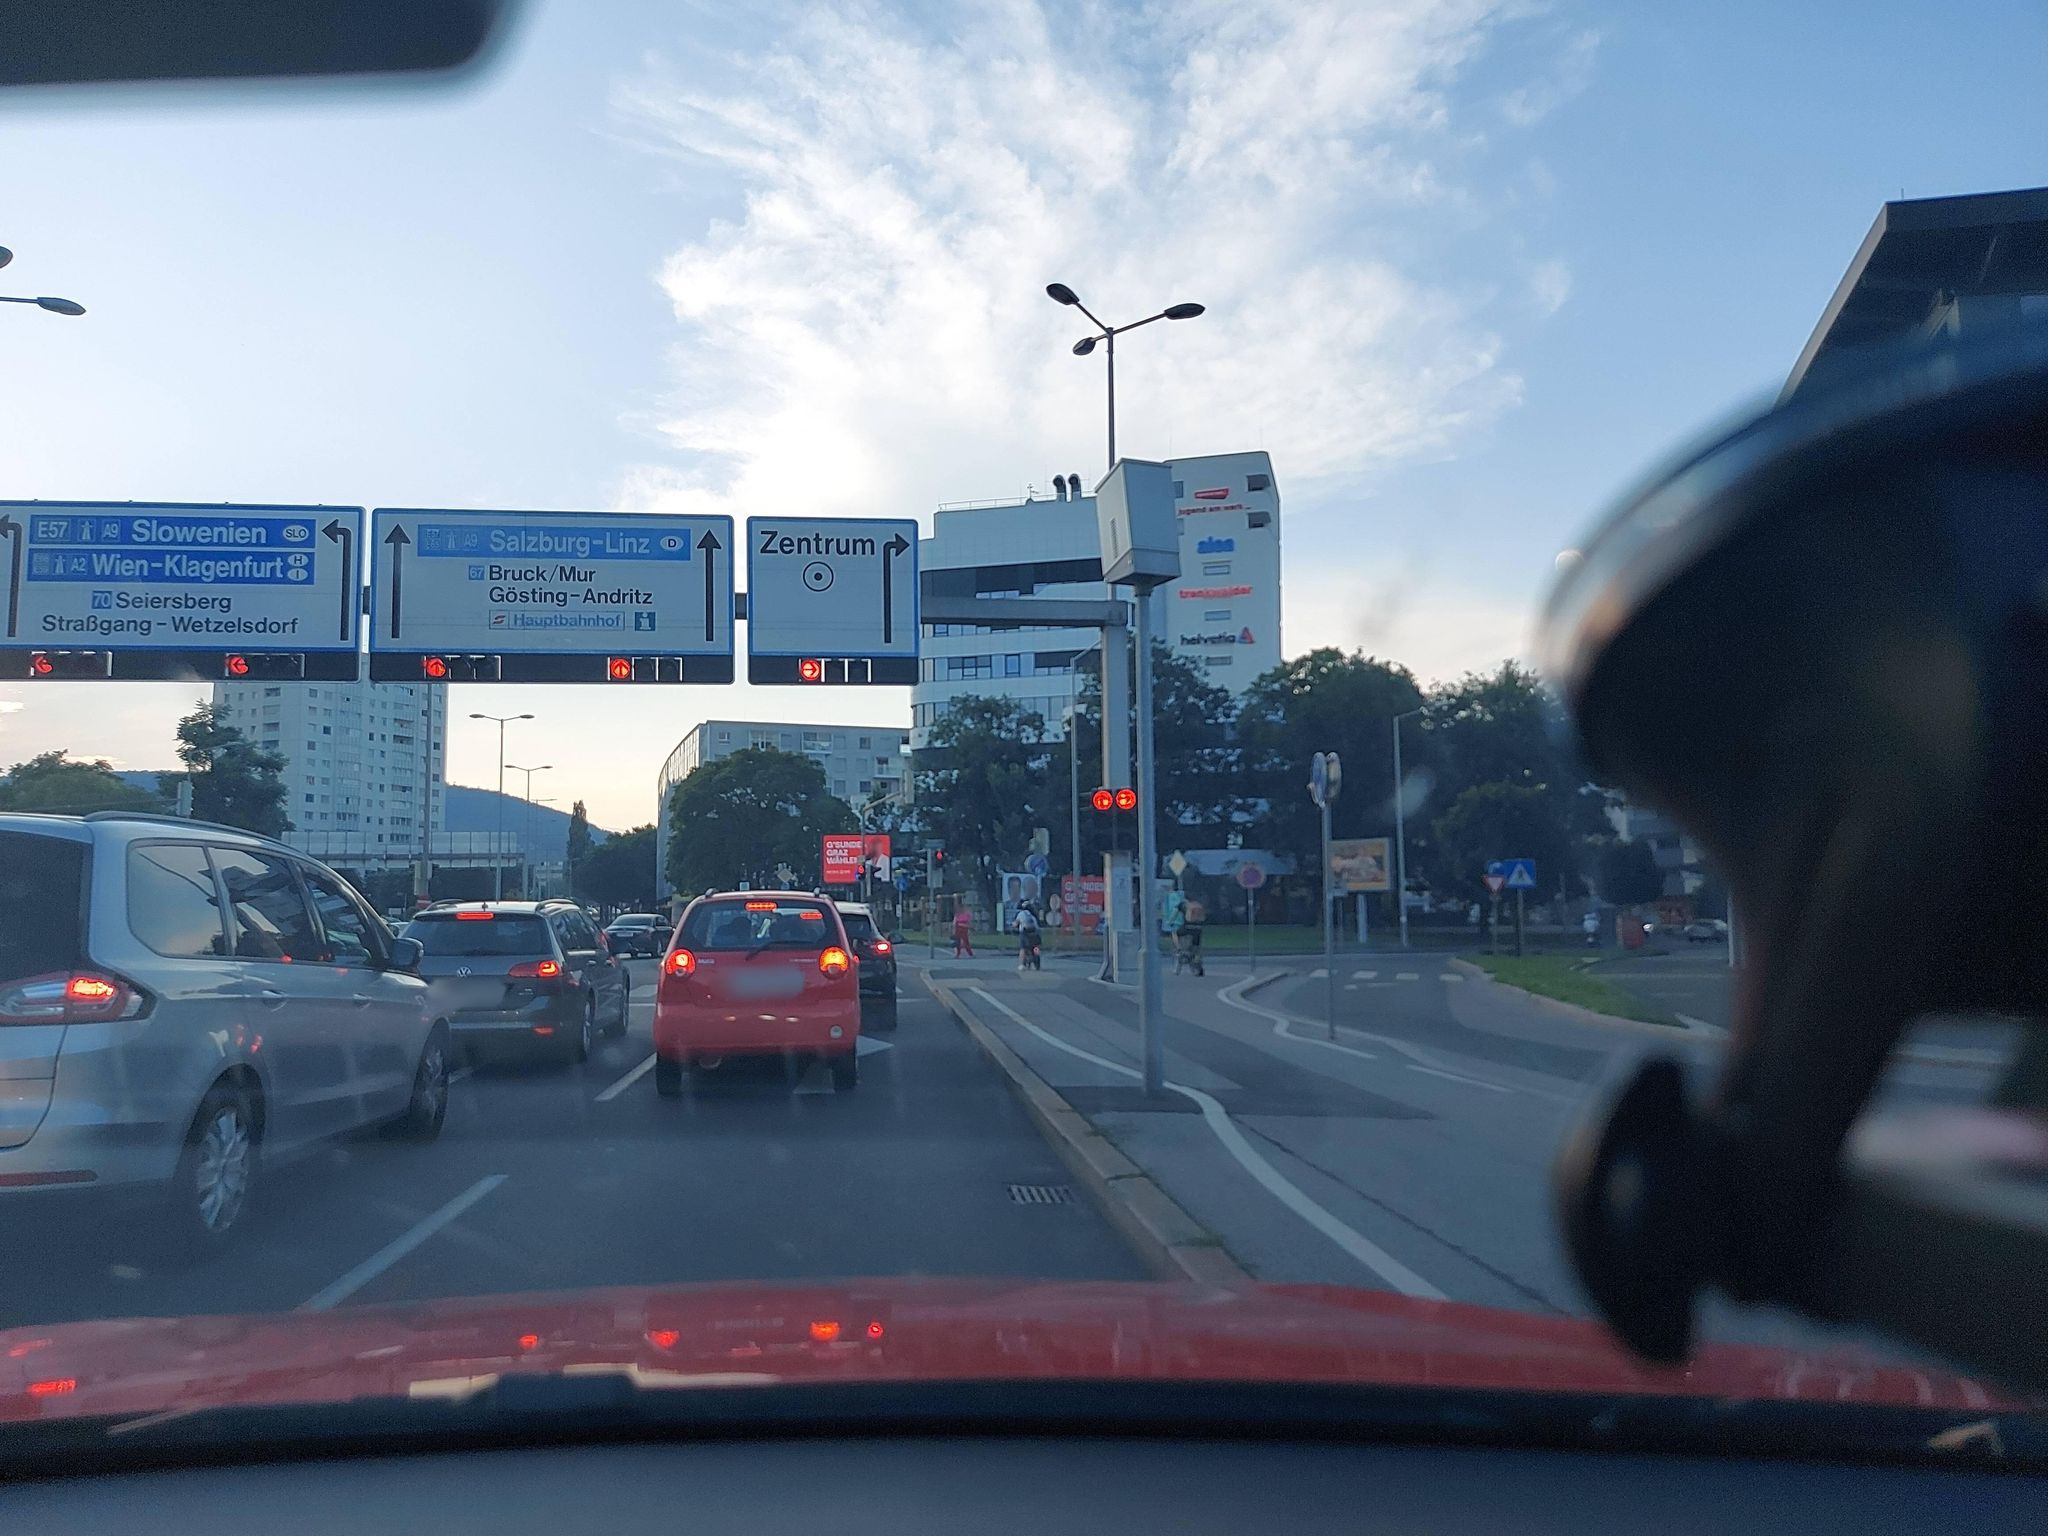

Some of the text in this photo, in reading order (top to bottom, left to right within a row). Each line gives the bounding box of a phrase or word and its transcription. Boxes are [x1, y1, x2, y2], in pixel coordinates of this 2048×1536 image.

[38, 521, 68, 538] E57
[131, 519, 267, 545] Slowenien
[285, 528, 307, 539] SLO
[760, 530, 875, 555] Zentrum
[489, 530, 650, 557] Salzburg-Linz
[667, 538, 677, 548] D
[92, 553, 284, 582] Wien-Klagenfurt
[294, 555, 303, 565] H
[469, 564, 596, 583] 67 Bruck/Mur
[93, 591, 232, 613] 70 Seiersberg
[489, 587, 653, 607] Gösting-Andritz
[42, 614, 152, 636] Straßgang
[172, 615, 299, 635] Wetzelsdorf
[513, 612, 622, 630] Hauptbahnhof
